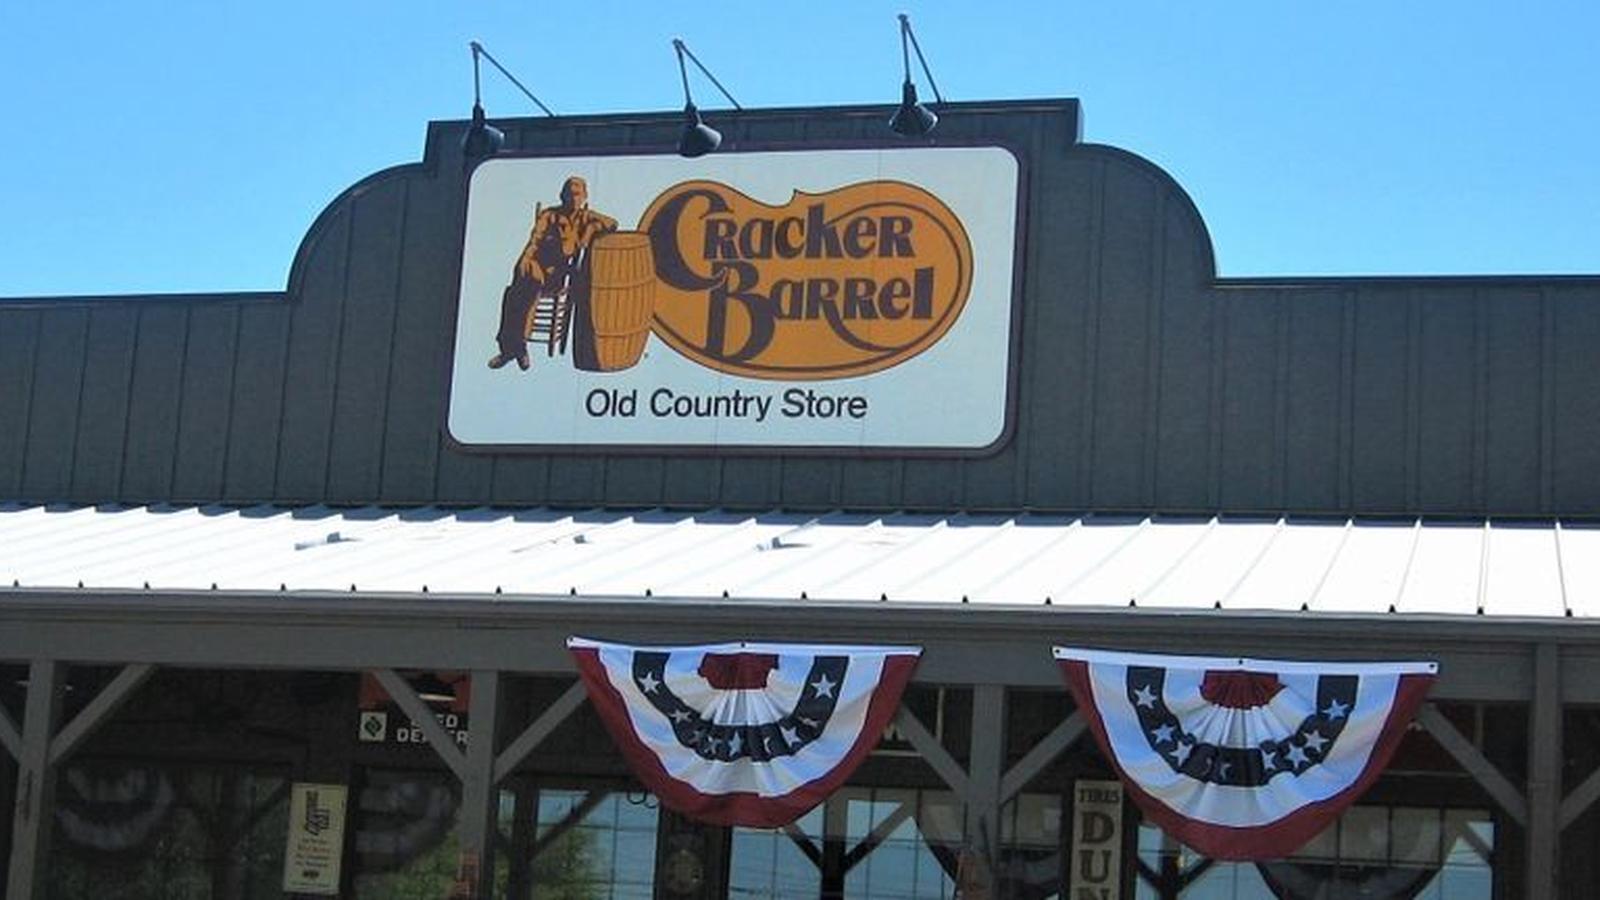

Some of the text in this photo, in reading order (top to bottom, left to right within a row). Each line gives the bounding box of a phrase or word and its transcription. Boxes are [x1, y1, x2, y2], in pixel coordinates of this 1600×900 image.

[650, 188, 915, 291] Cracker
[705, 261, 934, 363] Barrel
[586, 388, 868, 422] Old Country Store
